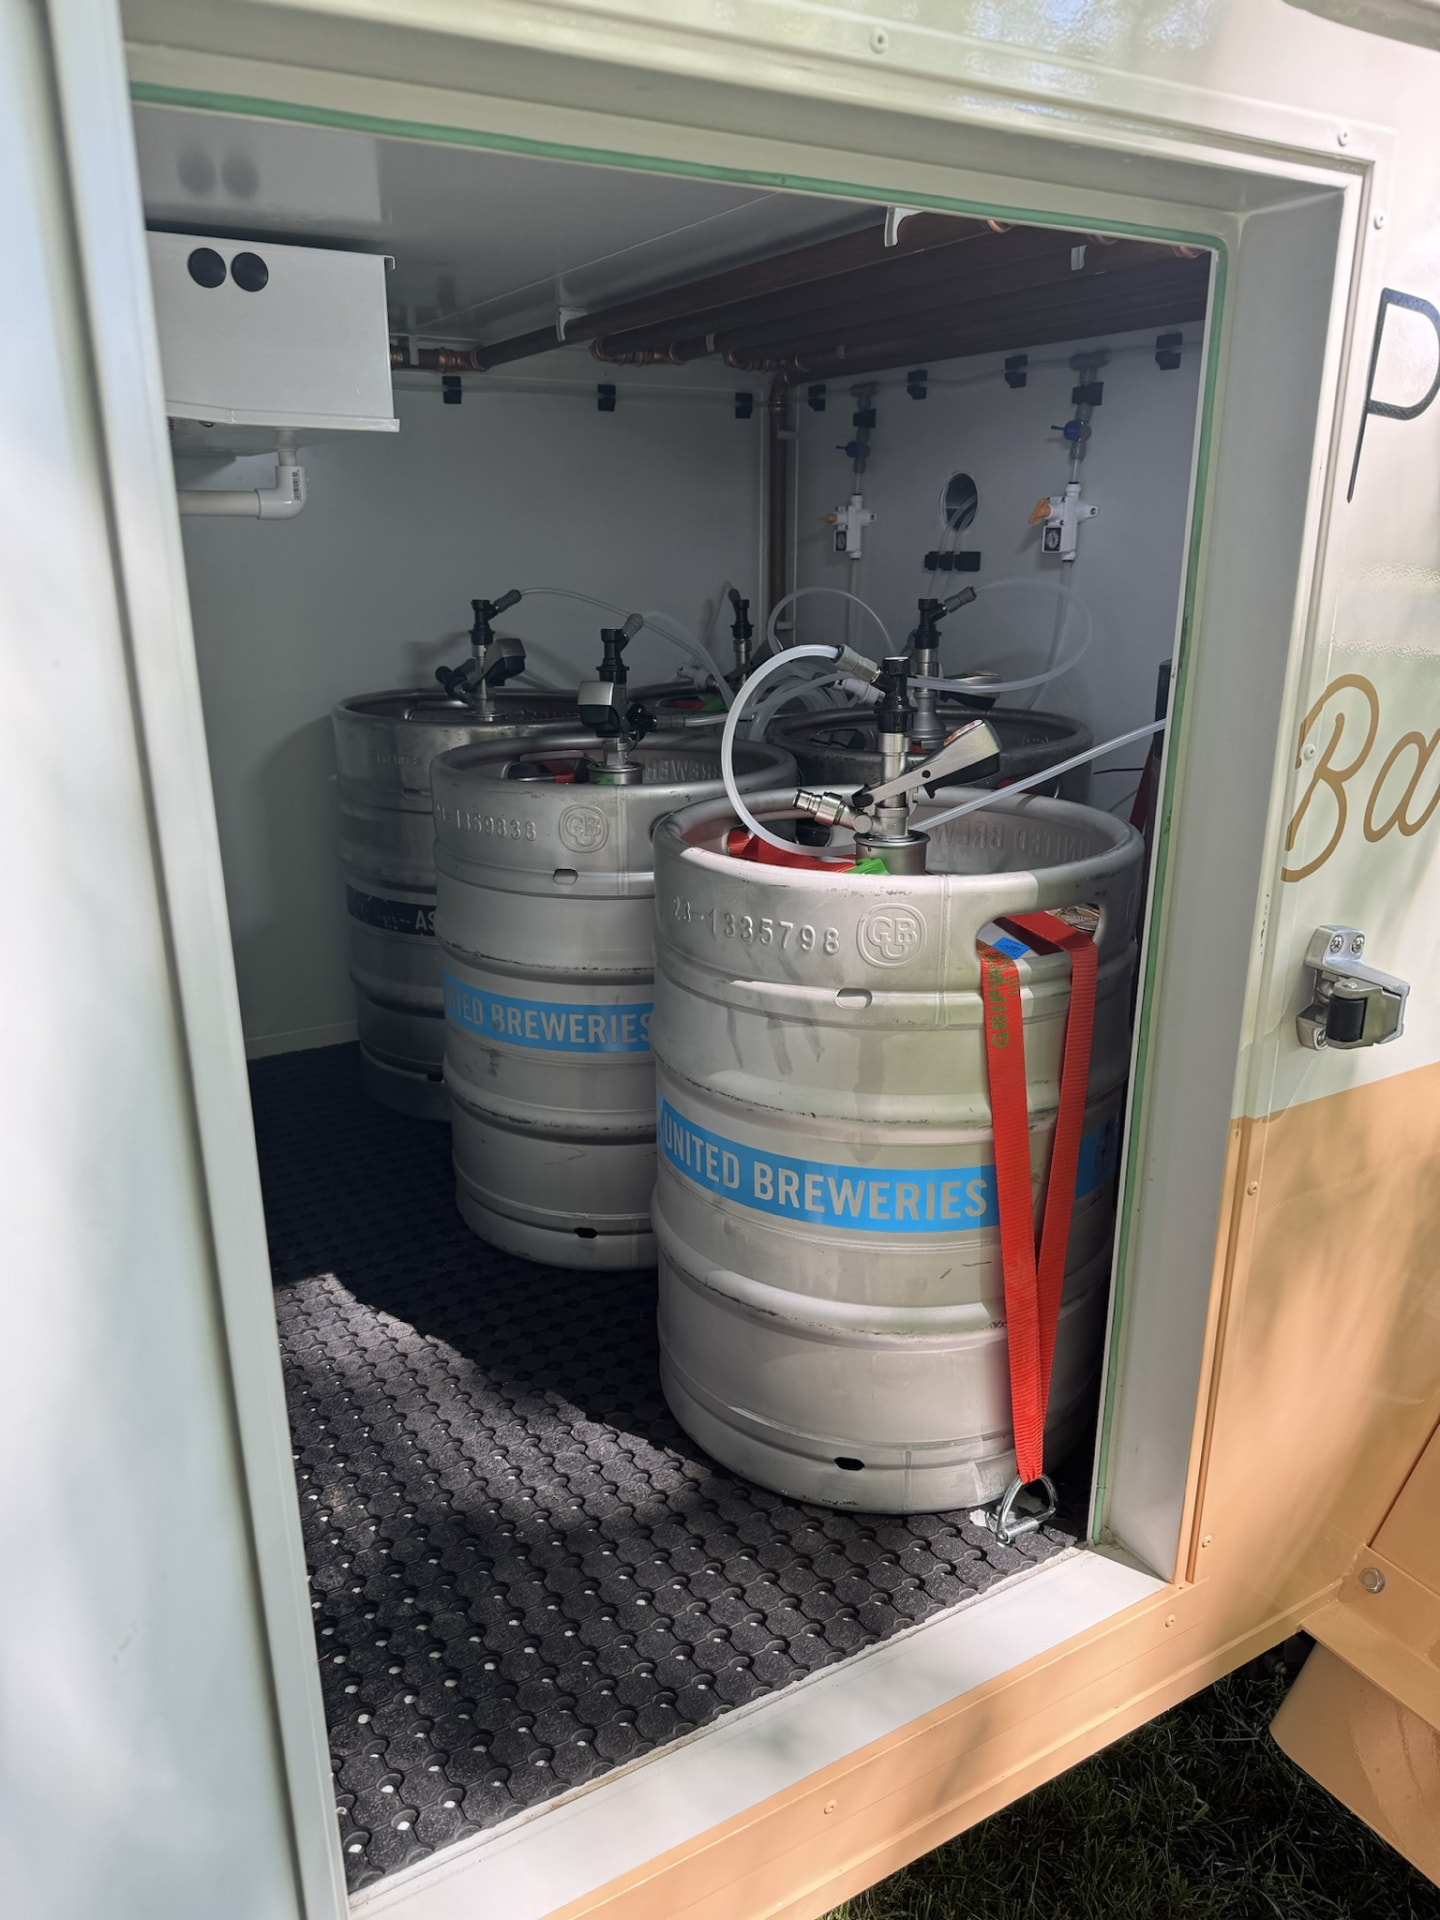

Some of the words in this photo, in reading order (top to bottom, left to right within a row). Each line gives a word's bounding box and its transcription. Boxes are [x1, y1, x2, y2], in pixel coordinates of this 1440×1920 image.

[491, 1003, 653, 1044] BREWERIES
[663, 1112, 740, 1190] UNITED
[753, 1160, 988, 1221] BREWERIES
